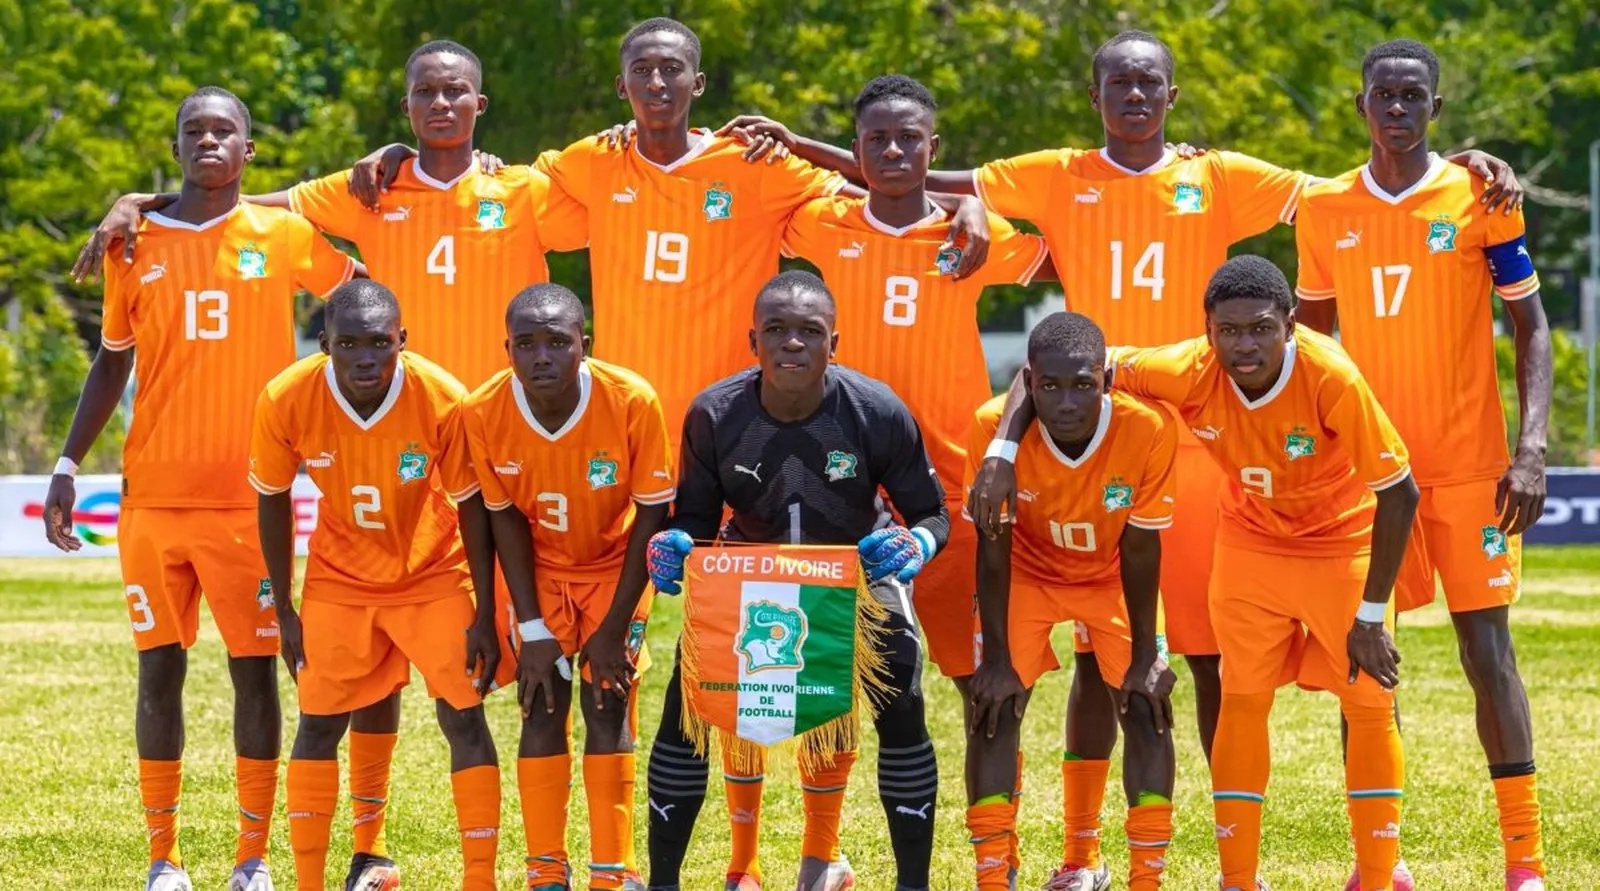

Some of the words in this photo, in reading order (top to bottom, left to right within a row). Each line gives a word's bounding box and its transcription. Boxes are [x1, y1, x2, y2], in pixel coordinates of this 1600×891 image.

[427, 235, 457, 285] 4
[643, 230, 690, 283] 19
[1110, 240, 1165, 301] 14
[883, 275, 919, 326] 8
[1371, 265, 1412, 318] 17
[184, 290, 229, 341] 13
[1241, 467, 1273, 499] 9
[352, 485, 385, 529] 2
[537, 492, 568, 532] 3
[1049, 520, 1096, 552] 10
[703, 552, 756, 574] CÔTE
[761, 554, 843, 580] D'IVOIRE
[700, 682, 768, 692] FEDERATION
[772, 685, 836, 695] IVOIRIENNE
[760, 696, 775, 705] DE
[738, 707, 794, 718] FOOTBALL
